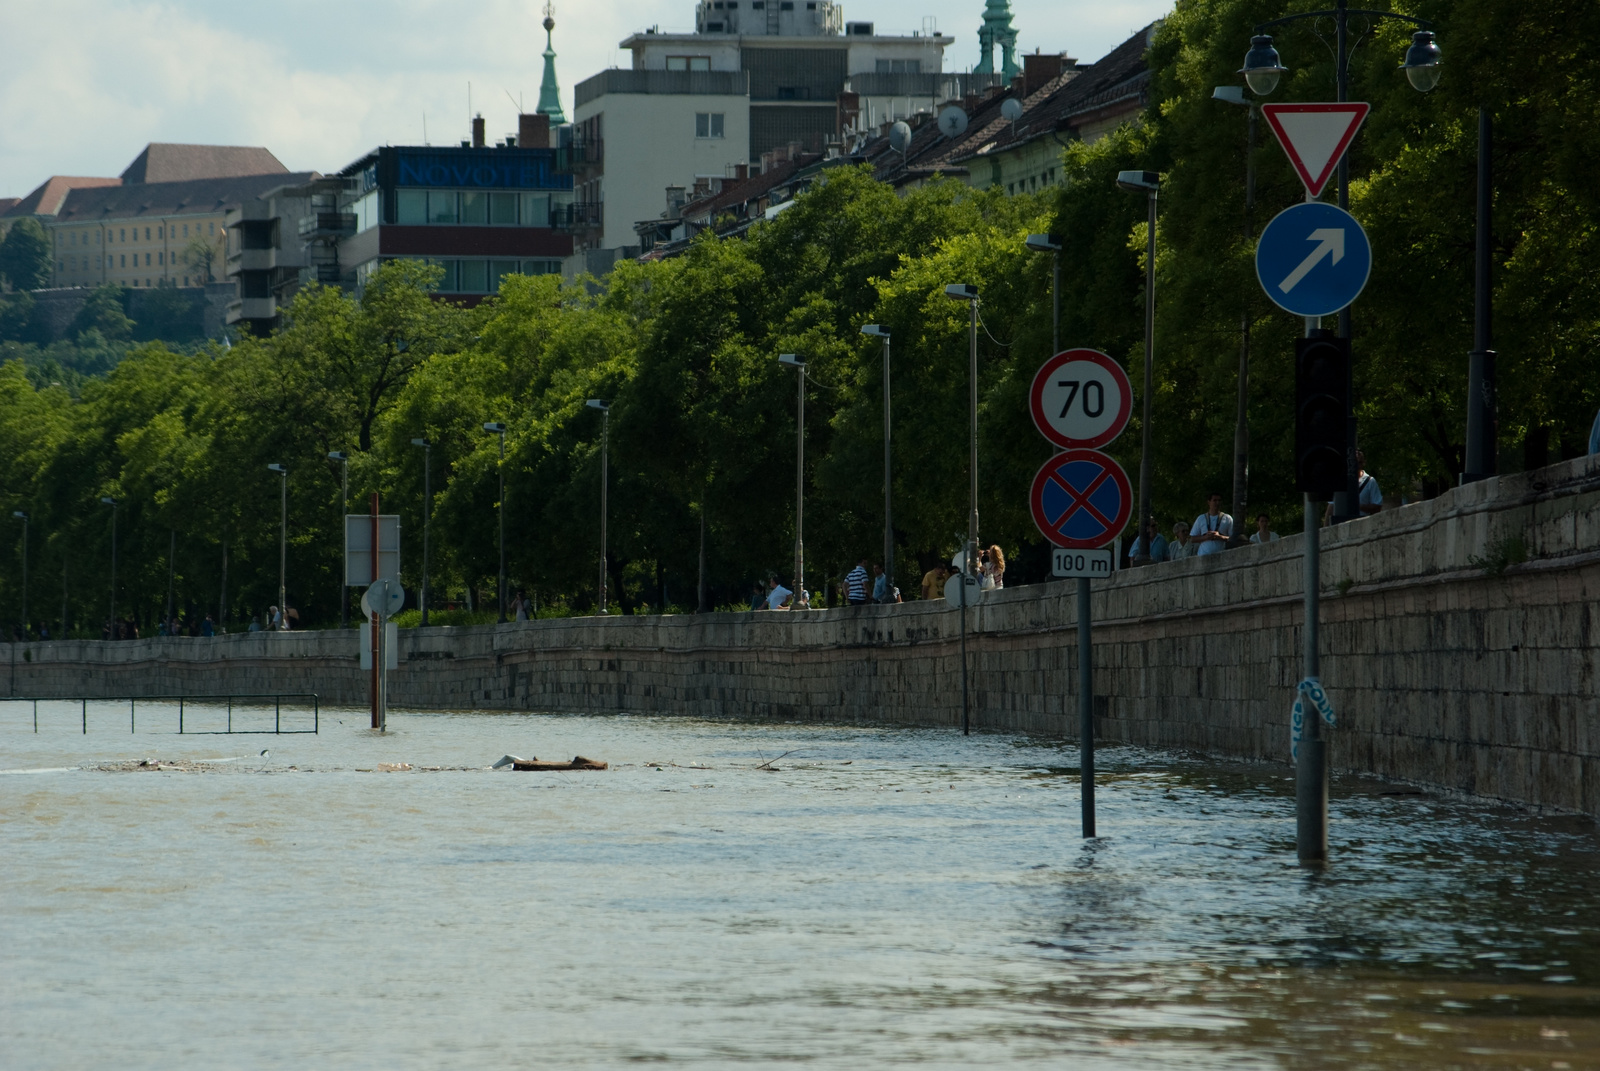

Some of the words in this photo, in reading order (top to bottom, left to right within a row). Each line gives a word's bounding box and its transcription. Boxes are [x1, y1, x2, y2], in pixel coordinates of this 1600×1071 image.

[399, 158, 558, 188] NOVOTEL
[1057, 380, 1104, 418] 70
[1056, 555, 1084, 571] 100
[1091, 559, 1107, 571] m
